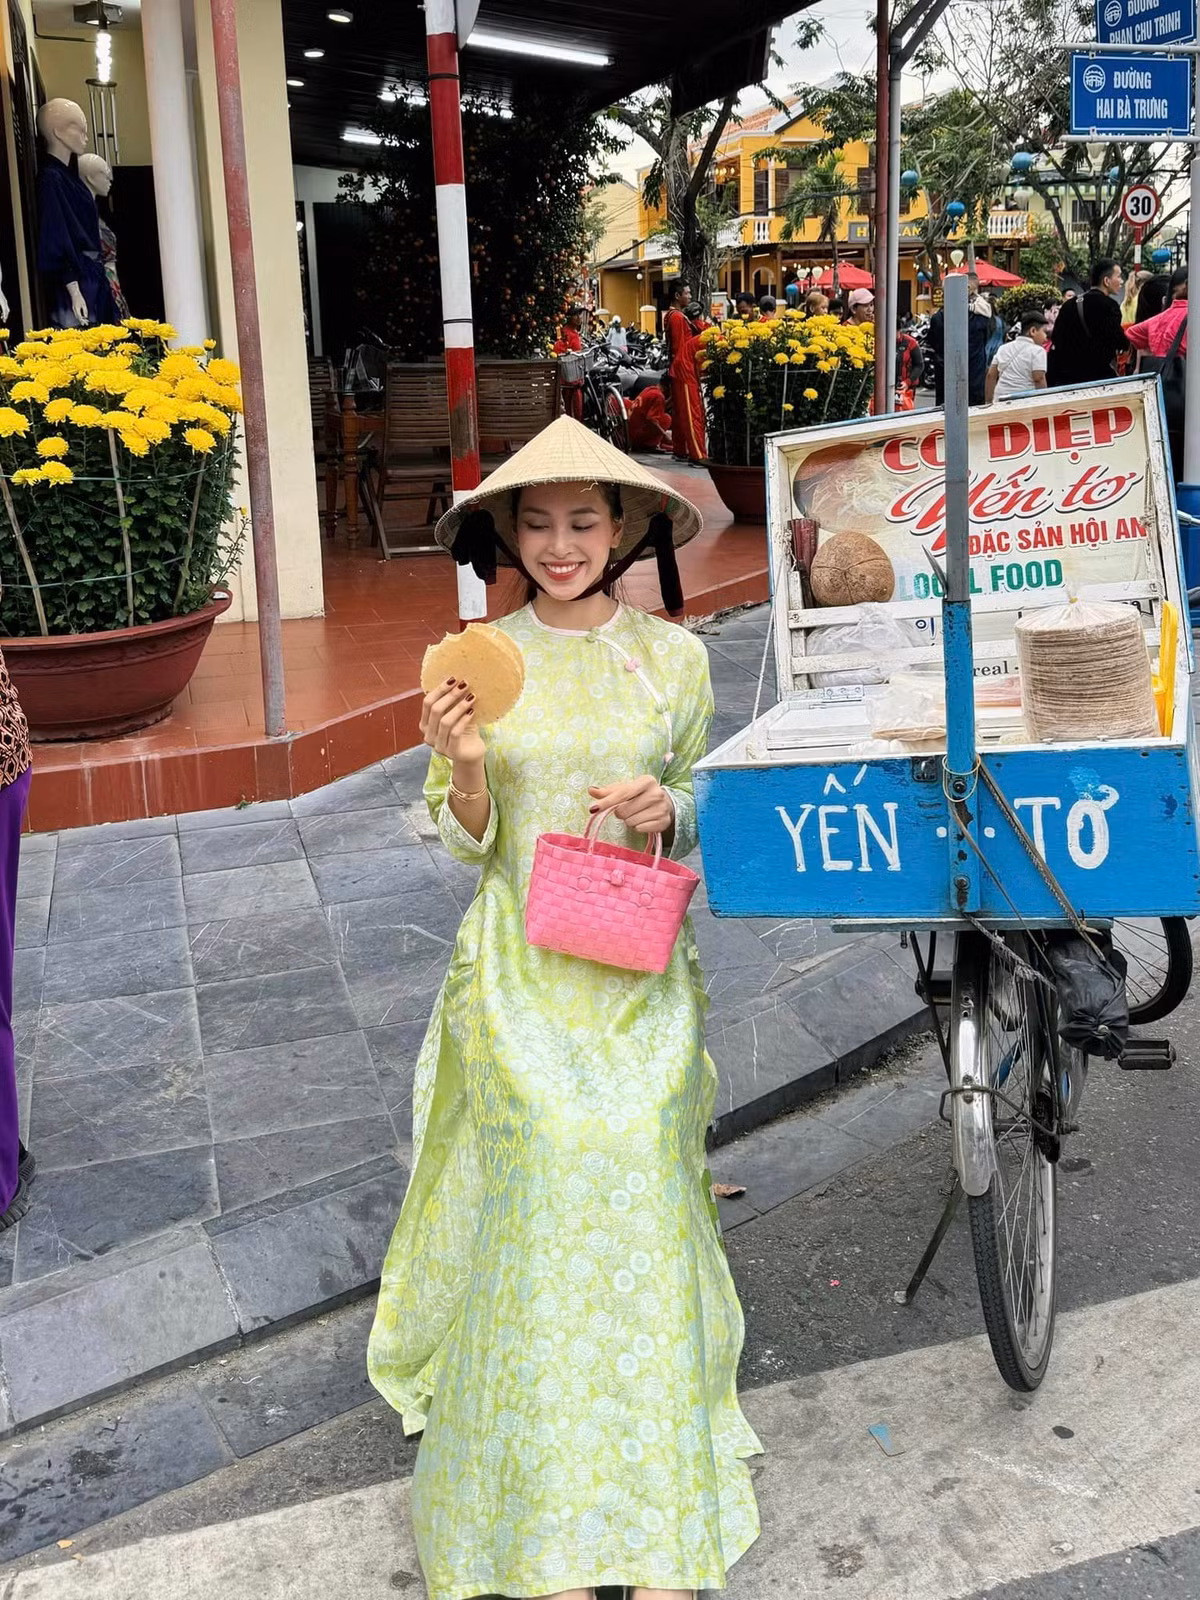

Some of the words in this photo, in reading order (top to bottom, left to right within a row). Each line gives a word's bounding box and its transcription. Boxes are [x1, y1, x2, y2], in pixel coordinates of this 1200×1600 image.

[1135, 19, 1153, 44] CHU
[1154, 10, 1181, 37] TRINH
[1113, 67, 1152, 90] ĐƯỜNG
[1096, 98, 1114, 119] HAI
[1117, 95, 1132, 119] BÀ
[1134, 97, 1168, 119] TRƯNG
[1130, 195, 1152, 216] 30
[987, 406, 1134, 463] DIỆP
[1061, 464, 1138, 509] tơ
[969, 528, 1010, 559] ĐẶC
[1018, 520, 1064, 551] SẢN
[1070, 517, 1108, 549] HỘI
[1116, 517, 1147, 541] AN
[899, 564, 983, 600] LOCL
[990, 558, 1063, 593] FOOD
[775, 764, 901, 873] YẾN
[1014, 785, 1120, 870] TƠ
